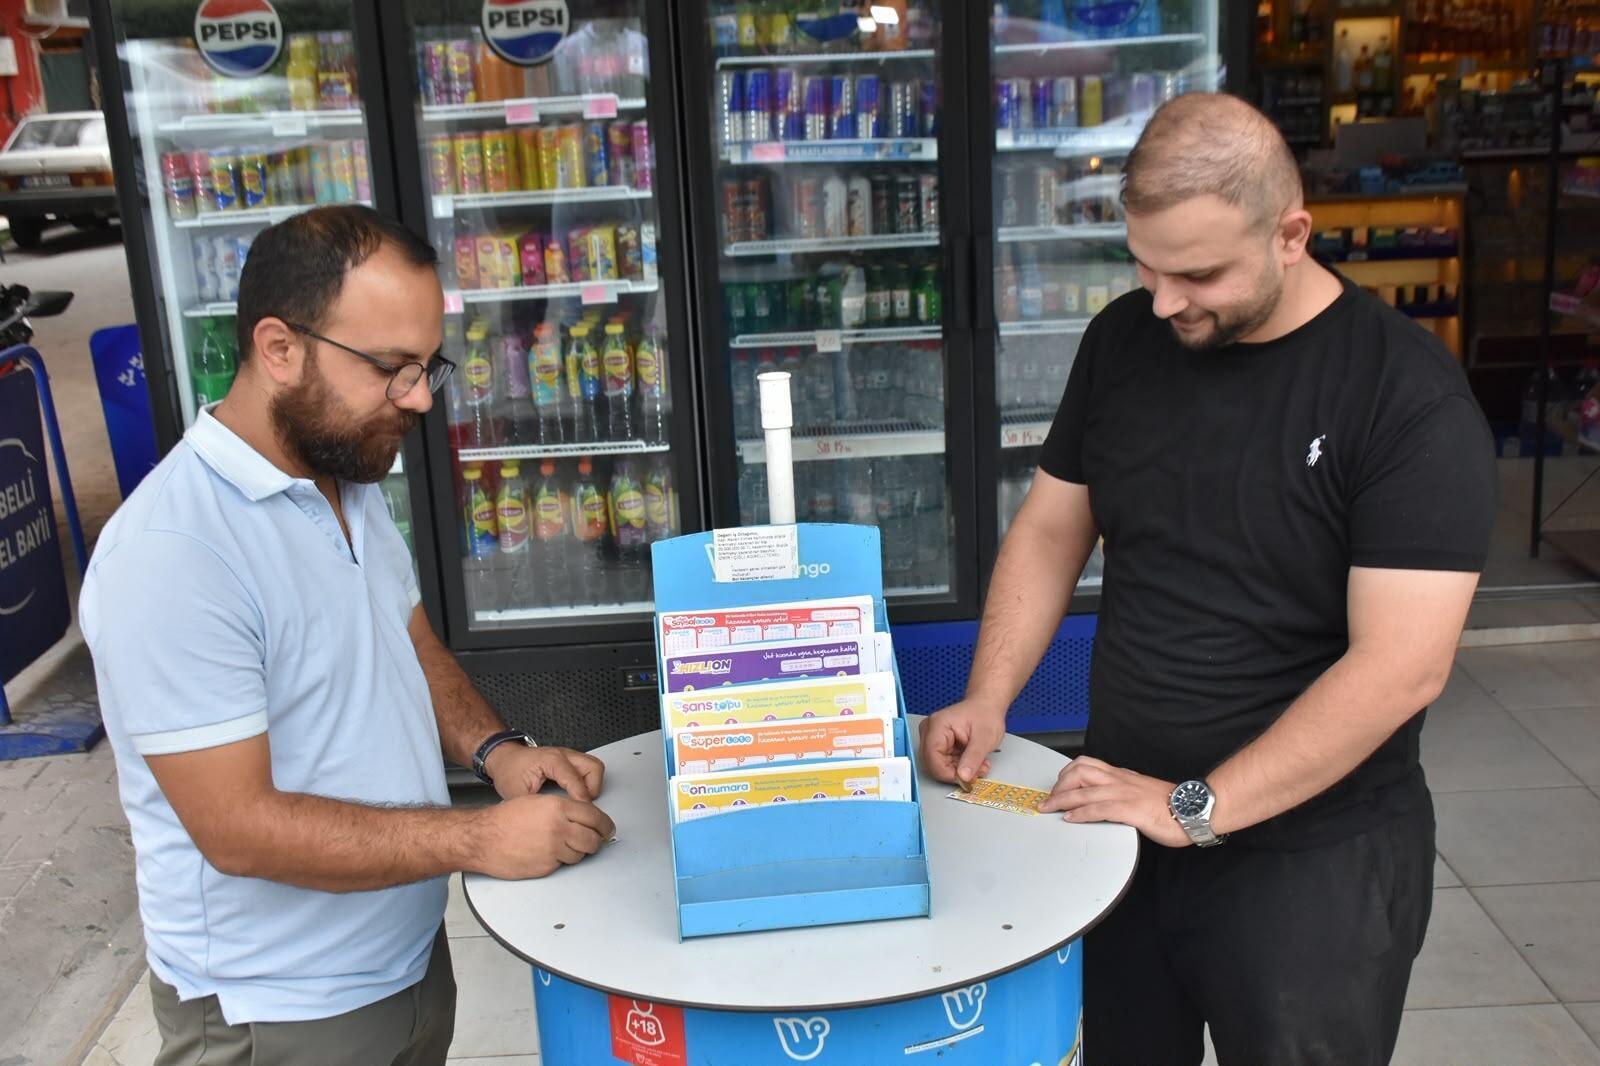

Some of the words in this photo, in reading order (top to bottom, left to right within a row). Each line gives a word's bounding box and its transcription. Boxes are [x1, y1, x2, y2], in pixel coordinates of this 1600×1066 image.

[488, 8, 564, 29] PEPSI
[201, 21, 277, 42] PEPSI
[799, 563, 831, 578] ngo
[682, 701, 713, 713] şans
[714, 699, 741, 711] topu
[691, 735, 726, 748] süper
[690, 785, 706, 795] on
[707, 783, 749, 794] numara
[632, 1019, 656, 1035] +18
